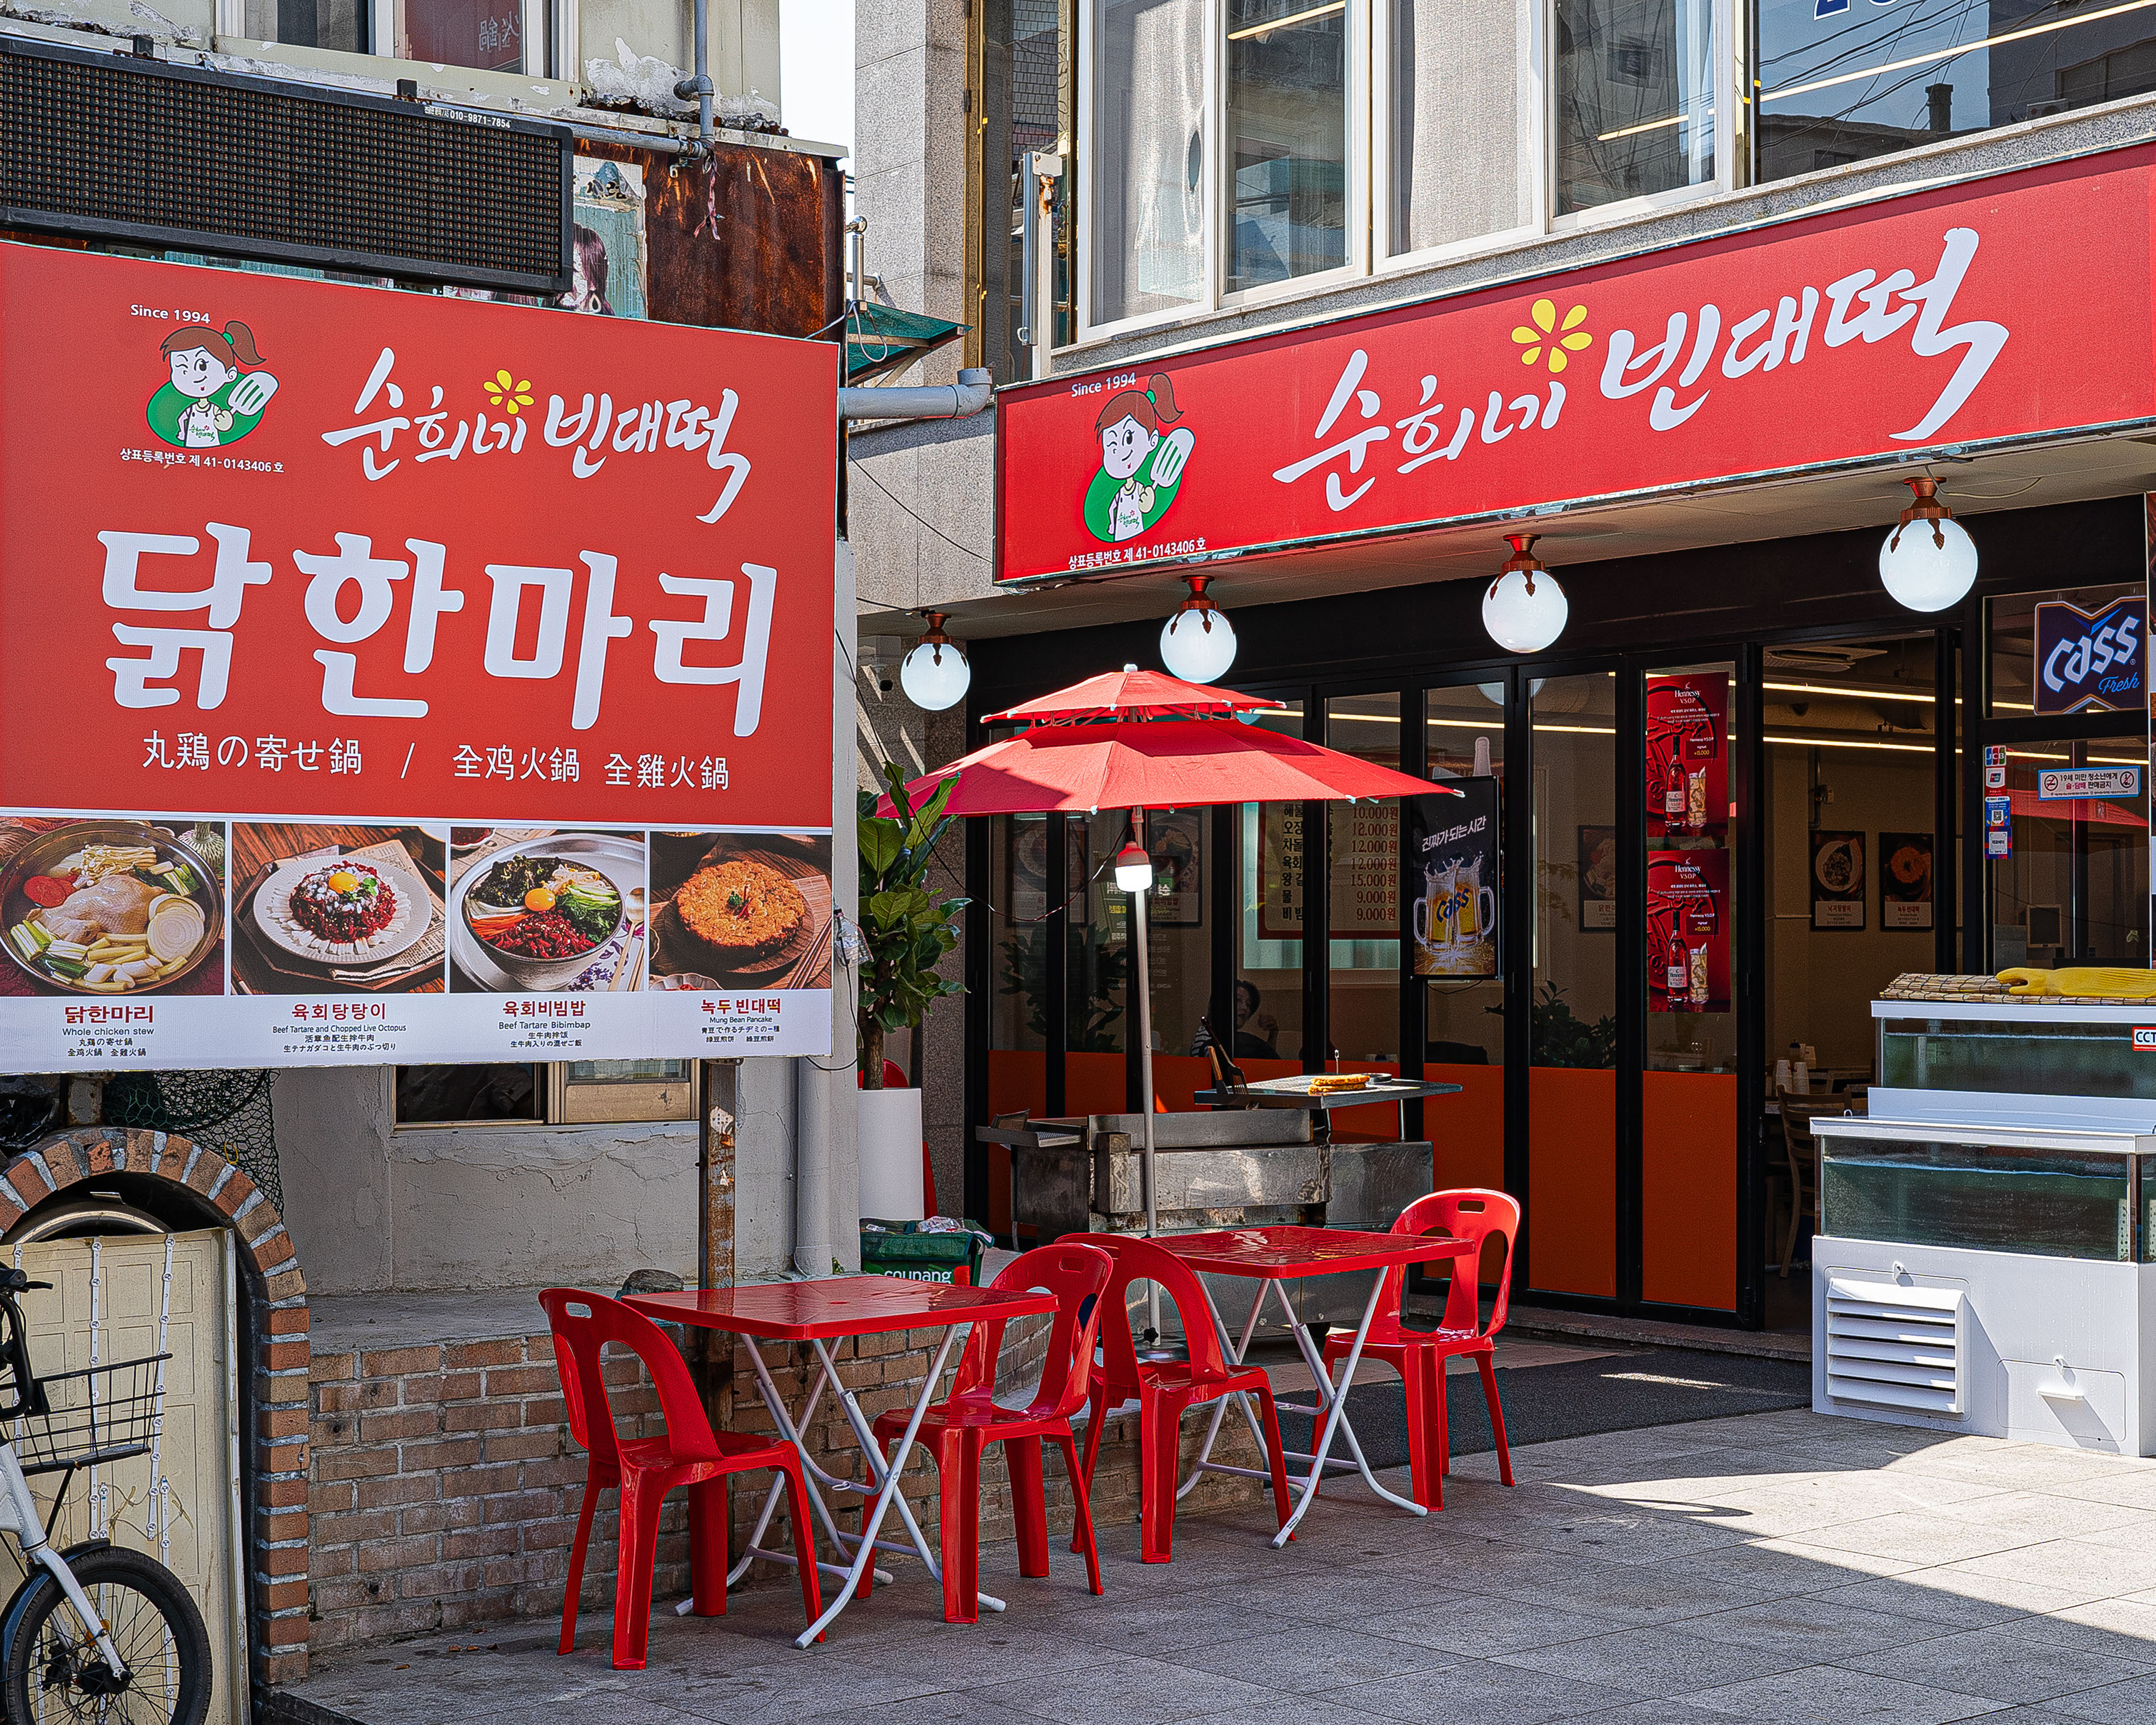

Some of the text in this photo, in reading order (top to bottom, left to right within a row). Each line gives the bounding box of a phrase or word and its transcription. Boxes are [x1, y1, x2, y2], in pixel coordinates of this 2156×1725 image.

[450, 110, 511, 129] 010-9871-7854
[131, 304, 211, 324] Since 1994
[1273, 226, 2010, 511] 순희네 빈대떡
[1071, 372, 1136, 398] Since 1994
[321, 346, 751, 524] 순희네 빈대떡
[120, 448, 186, 465] 상표등록번호
[189, 455, 200, 467] 제
[1068, 549, 1122, 570] 상표등록번호
[1123, 547, 1133, 562] 제
[97, 521, 777, 736] 닭한마리
[2098, 672, 2140, 694] Fresh
[2087, 781, 2111, 789] 판매금지
[2088, 772, 2117, 781] 청소년에게
[1468, 815, 1486, 834] 시간
[1675, 865, 1701, 874] Hennessy
[65, 1006, 153, 1024] 닭한마리
[291, 1003, 386, 1021] 육회탕탕이
[503, 1000, 586, 1017] 육회비빔밥
[701, 998, 781, 1014] 녹두 빈대떡
[331, 1024, 361, 1033] Chopped
[378, 1024, 406, 1033] Octopus
[551, 1021, 591, 1030] Bibimbap
